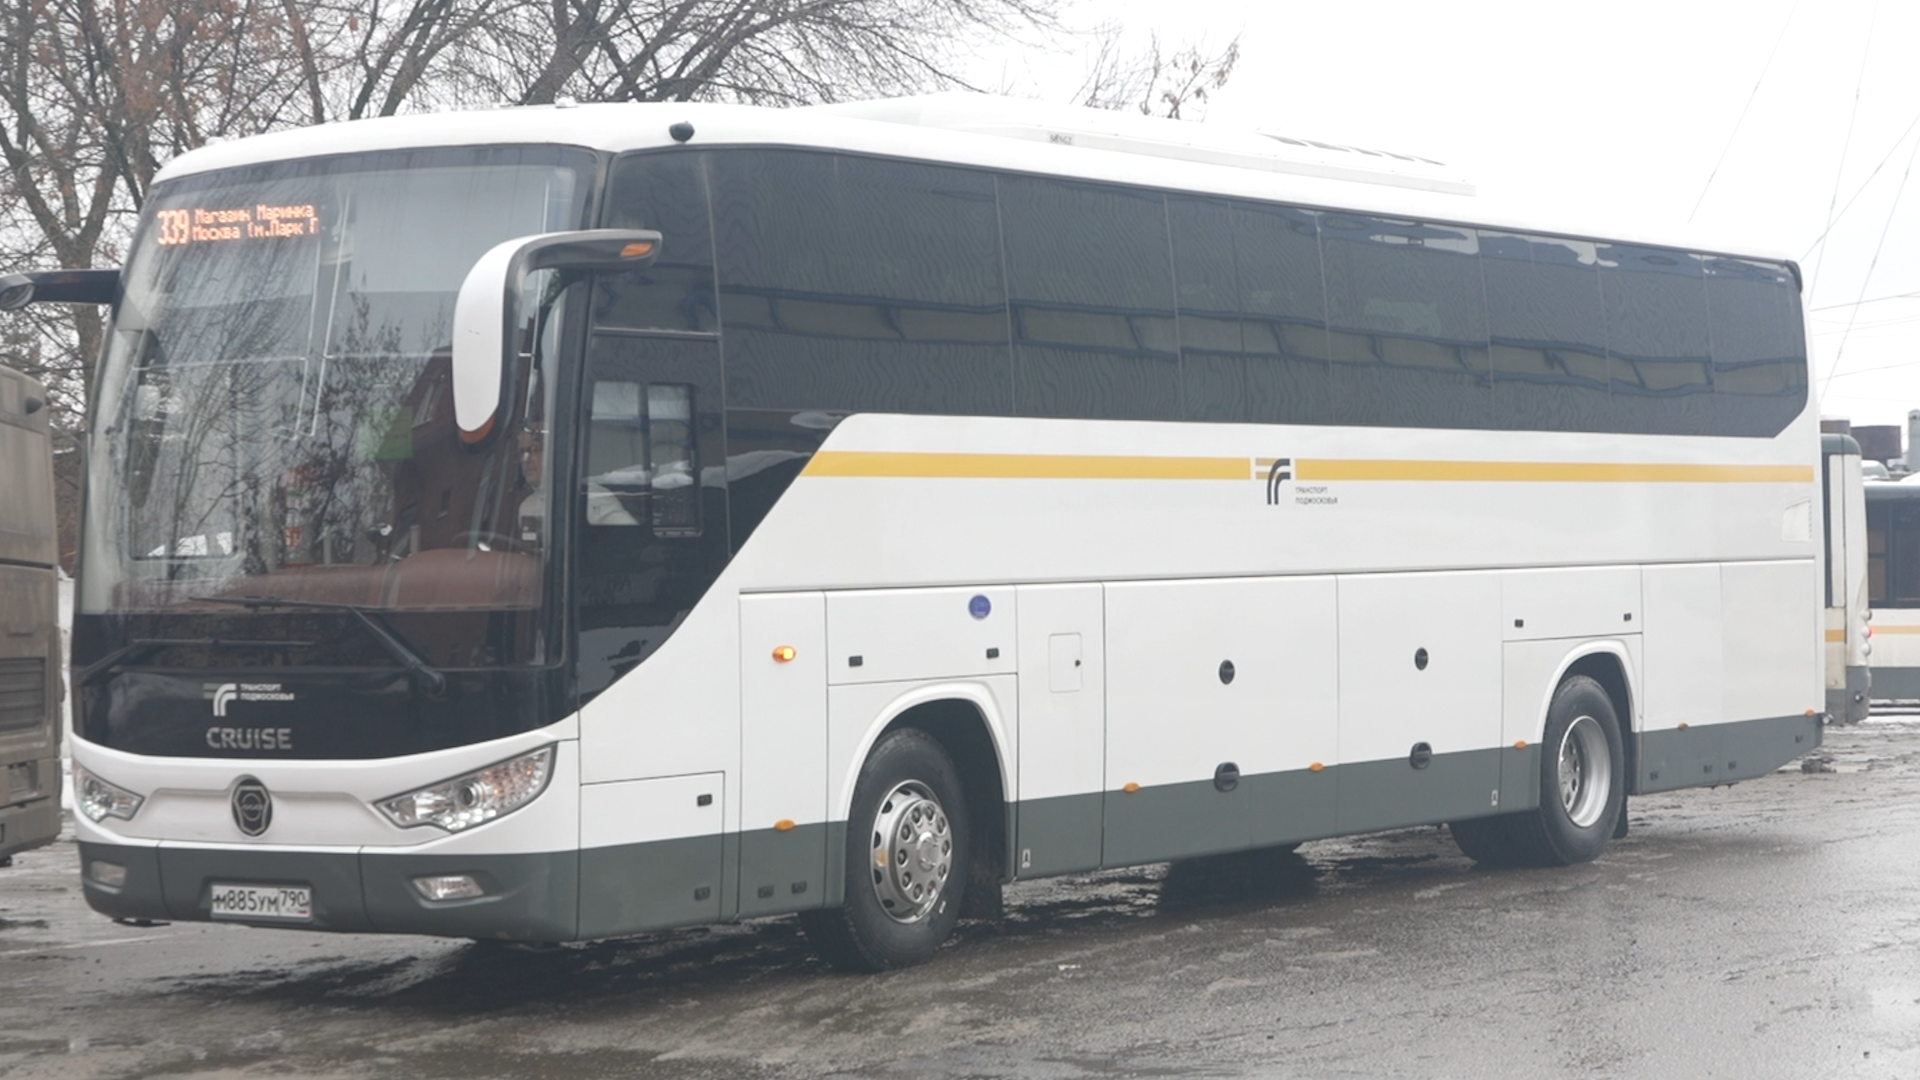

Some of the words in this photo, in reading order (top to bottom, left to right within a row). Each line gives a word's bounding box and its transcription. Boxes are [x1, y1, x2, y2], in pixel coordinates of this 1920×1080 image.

[195, 209, 251, 224] Магазин
[256, 204, 315, 221] Маринка
[157, 209, 190, 245] 339
[192, 225, 241, 241] Москва
[206, 727, 292, 750] CRUISE
